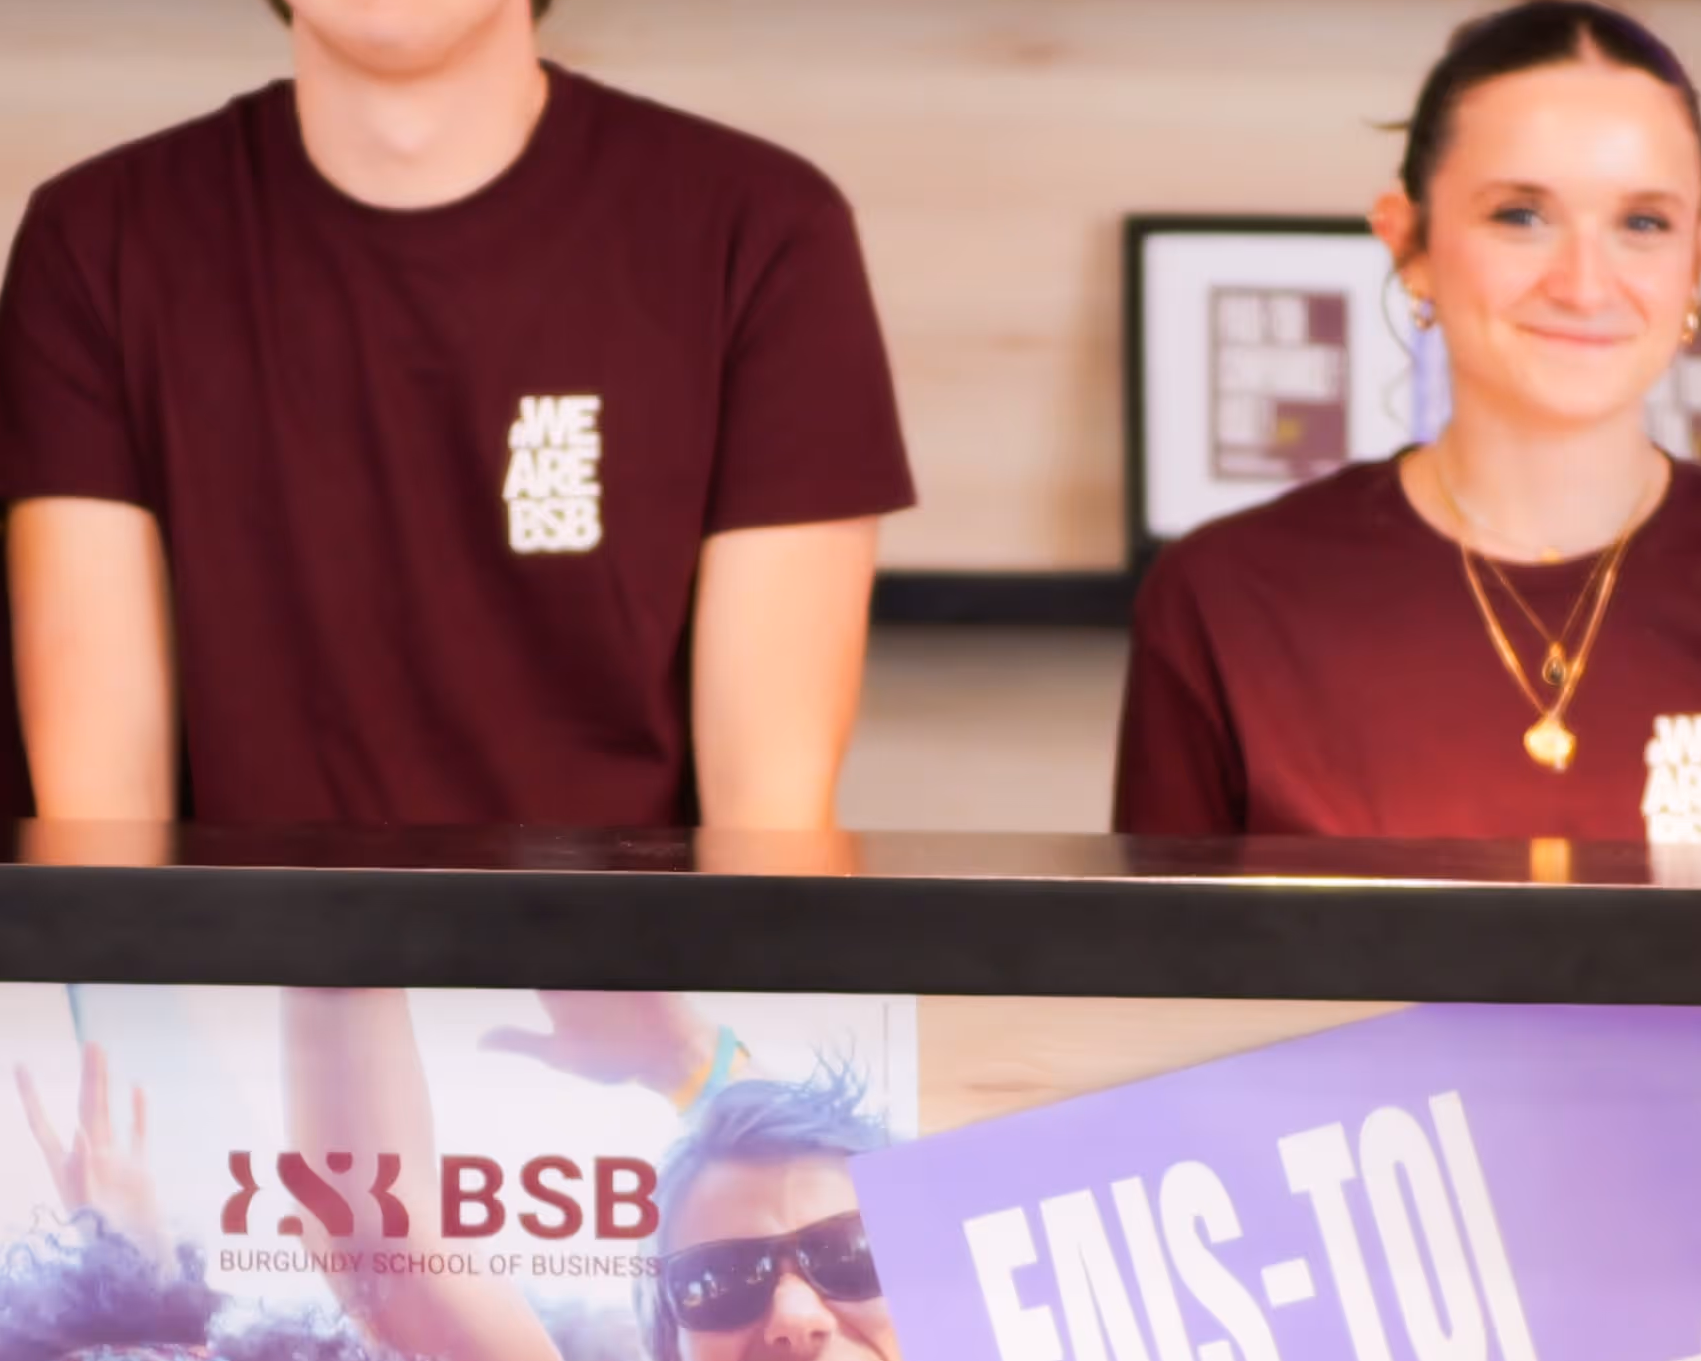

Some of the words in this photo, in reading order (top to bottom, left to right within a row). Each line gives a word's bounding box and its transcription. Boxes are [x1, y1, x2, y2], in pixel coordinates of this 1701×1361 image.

[440, 1154, 661, 1241] BSB
[219, 1249, 362, 1274] BURGUNDY
[372, 1251, 480, 1276] SCHOOL
[489, 1253, 521, 1276] OF
[531, 1254, 663, 1279] BUSINESS
